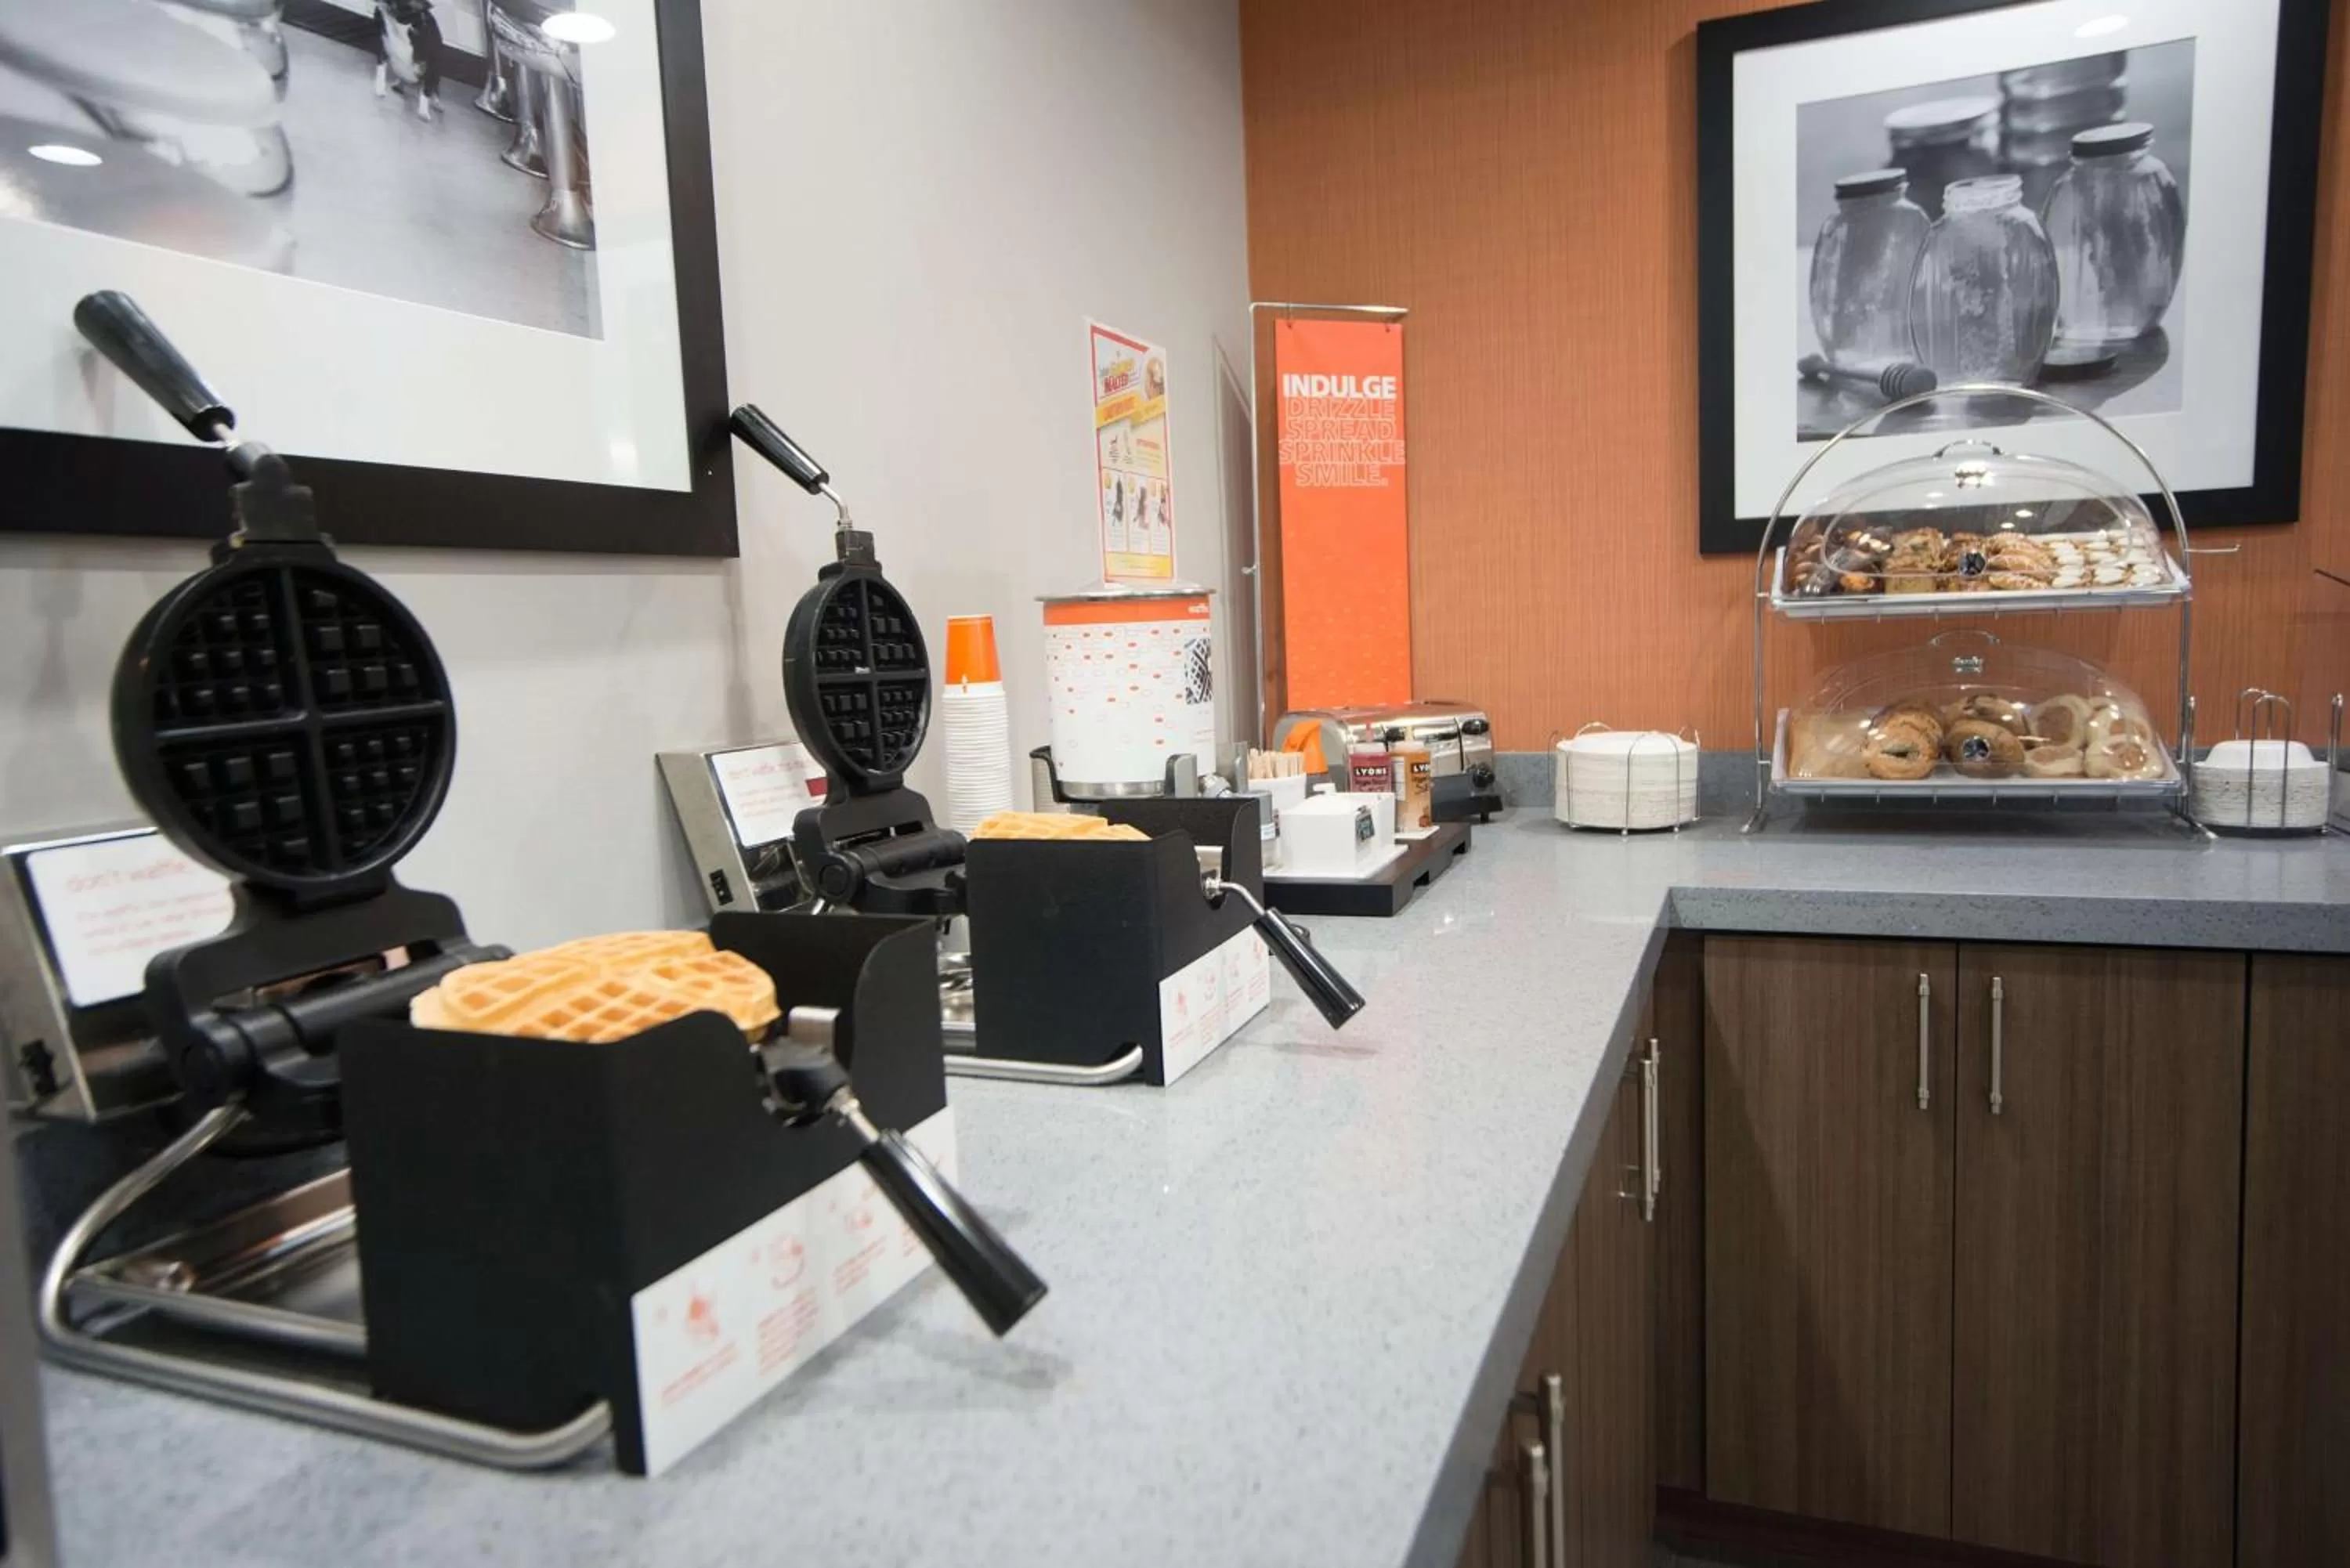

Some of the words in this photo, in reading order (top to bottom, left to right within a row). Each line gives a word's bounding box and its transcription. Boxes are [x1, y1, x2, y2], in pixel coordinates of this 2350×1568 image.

[1282, 373, 1396, 399] INDULGE
[1287, 397, 1395, 419] DRIZZLE
[1286, 418, 1395, 440] SPREAD
[1278, 439, 1405, 464] SPRINKLE
[1296, 463, 1389, 486] SMILE.
